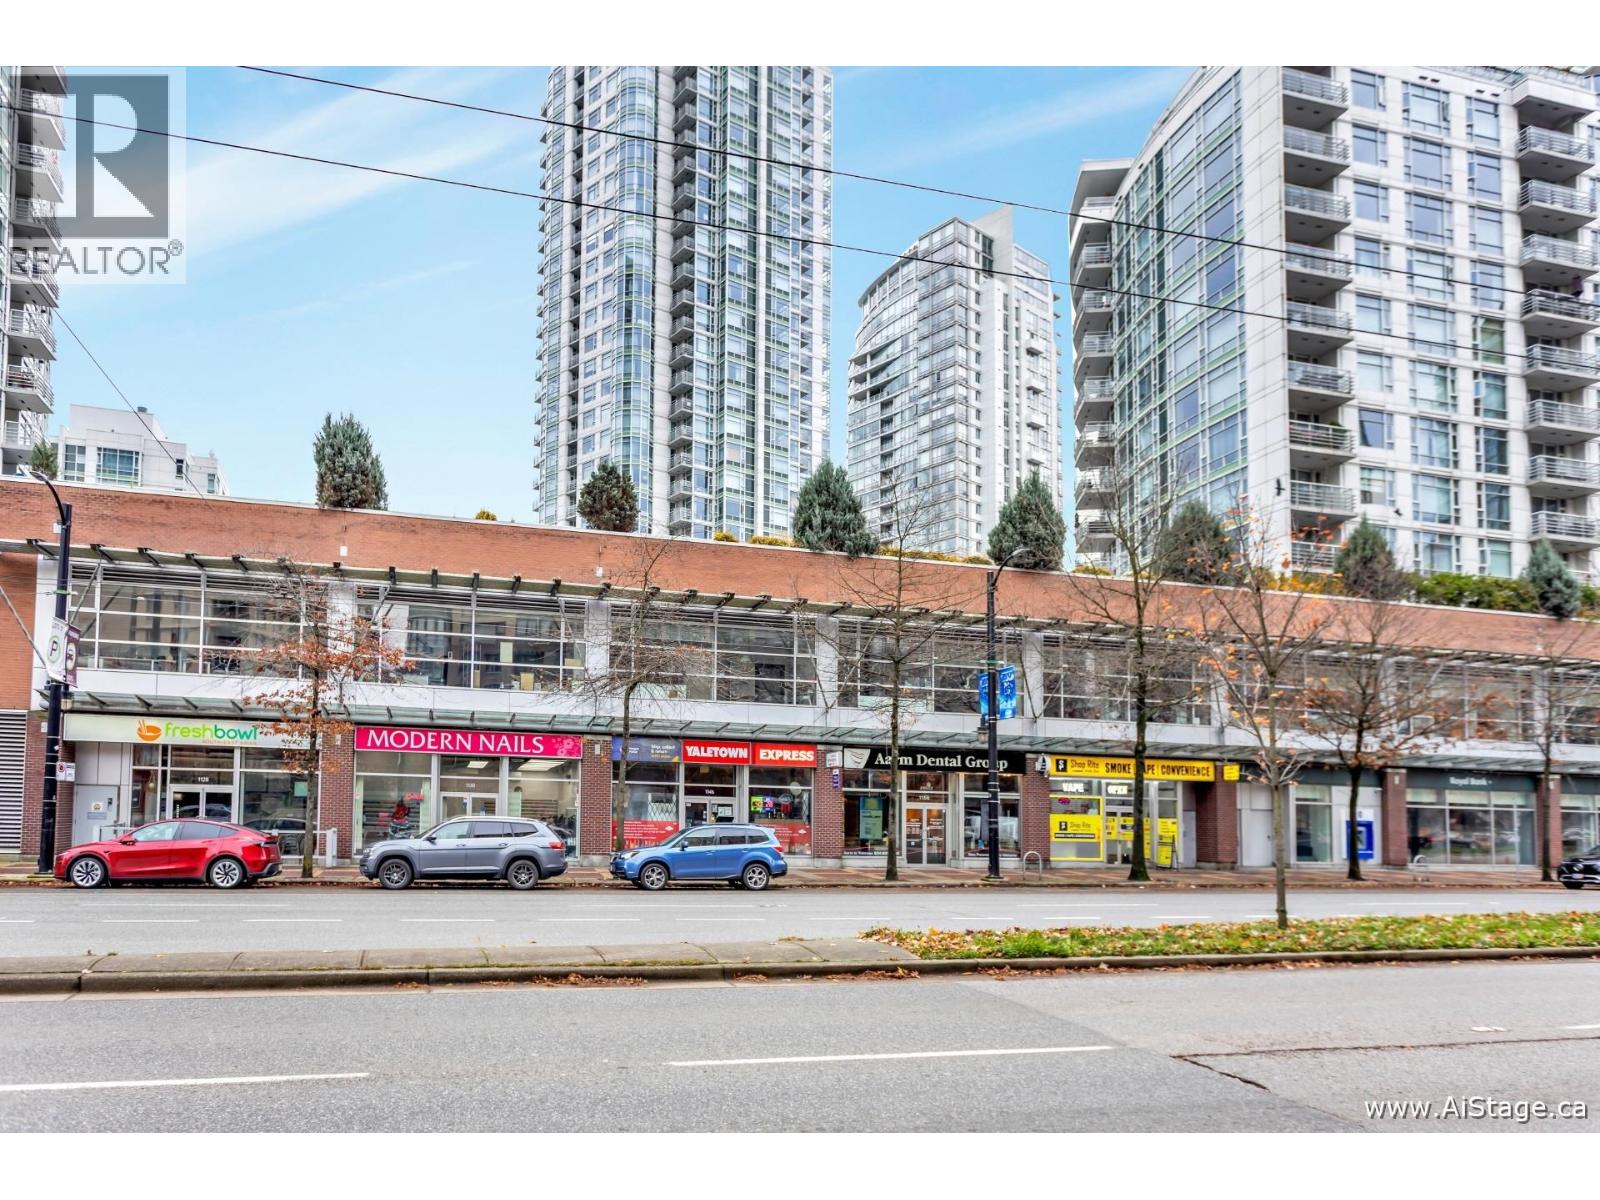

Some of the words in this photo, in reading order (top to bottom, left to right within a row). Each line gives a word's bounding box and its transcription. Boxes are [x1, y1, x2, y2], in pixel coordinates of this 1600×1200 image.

[165, 721, 257, 741] freshbowl
[366, 729, 472, 751] MODERN
[479, 733, 545, 754] NAILS
[685, 745, 749, 759] YALETOWN
[759, 749, 815, 762] EXPRESS
[874, 752, 914, 766] Aam
[916, 754, 962, 768] Dental
[1105, 762, 1132, 774] SMOKE
[1160, 764, 1210, 777] CONVENIENCE
[1062, 782, 1085, 793] VAPE
